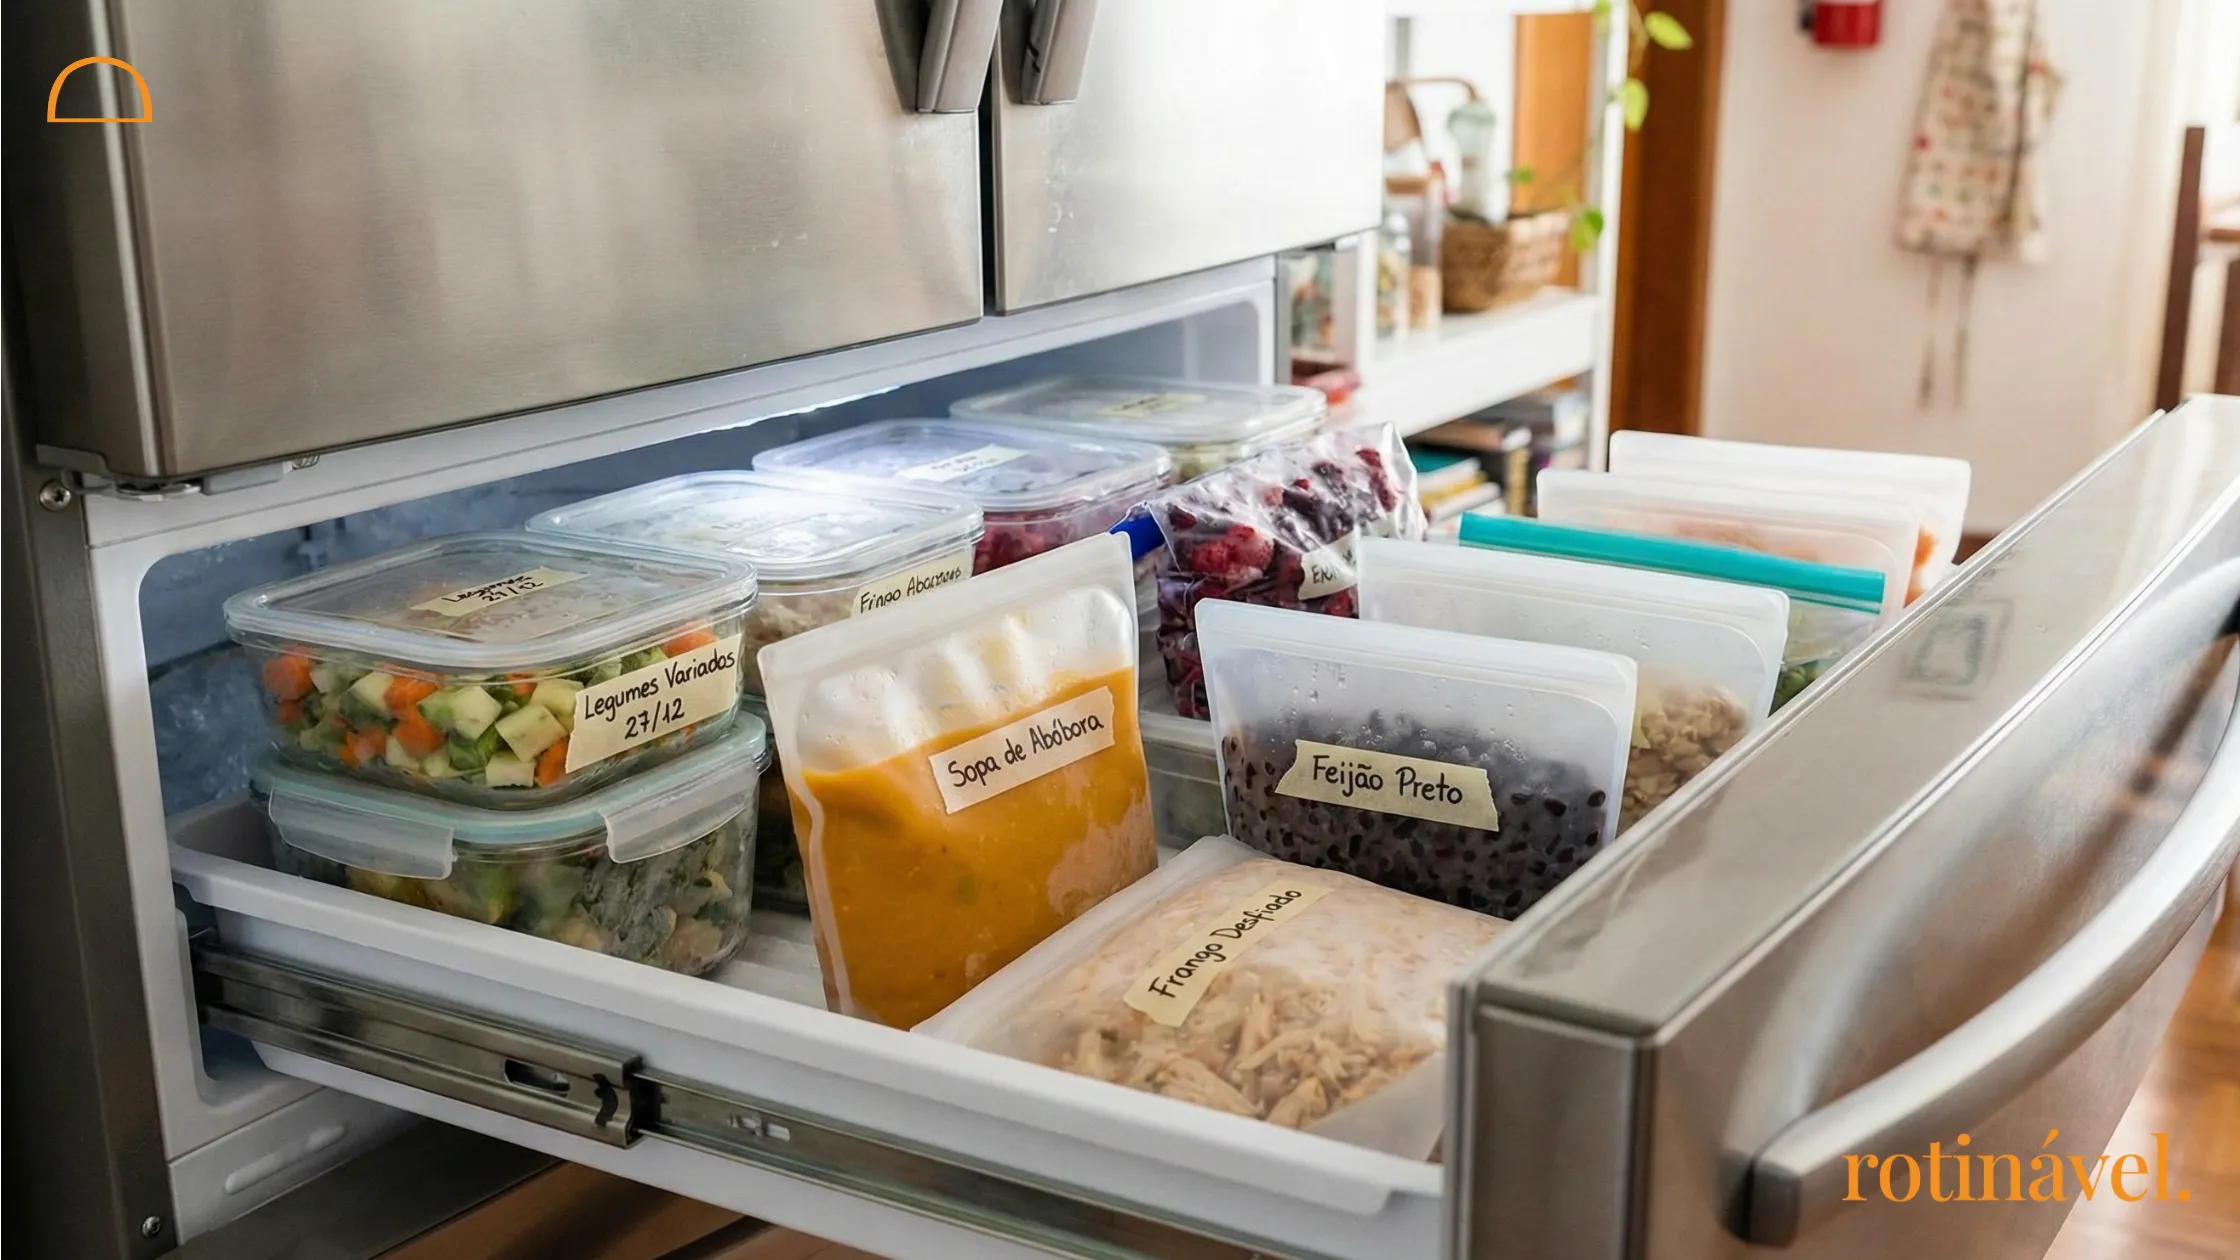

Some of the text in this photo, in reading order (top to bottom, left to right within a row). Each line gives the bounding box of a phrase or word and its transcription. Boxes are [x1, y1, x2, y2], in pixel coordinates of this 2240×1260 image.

[585, 648, 736, 722] Legumes Variados
[624, 698, 686, 740] 27/12
[947, 714, 1105, 788] Sopa de Abóbora
[1312, 755, 1464, 805] Feijão Preto
[1147, 889, 1303, 999] Frango Desfiado
